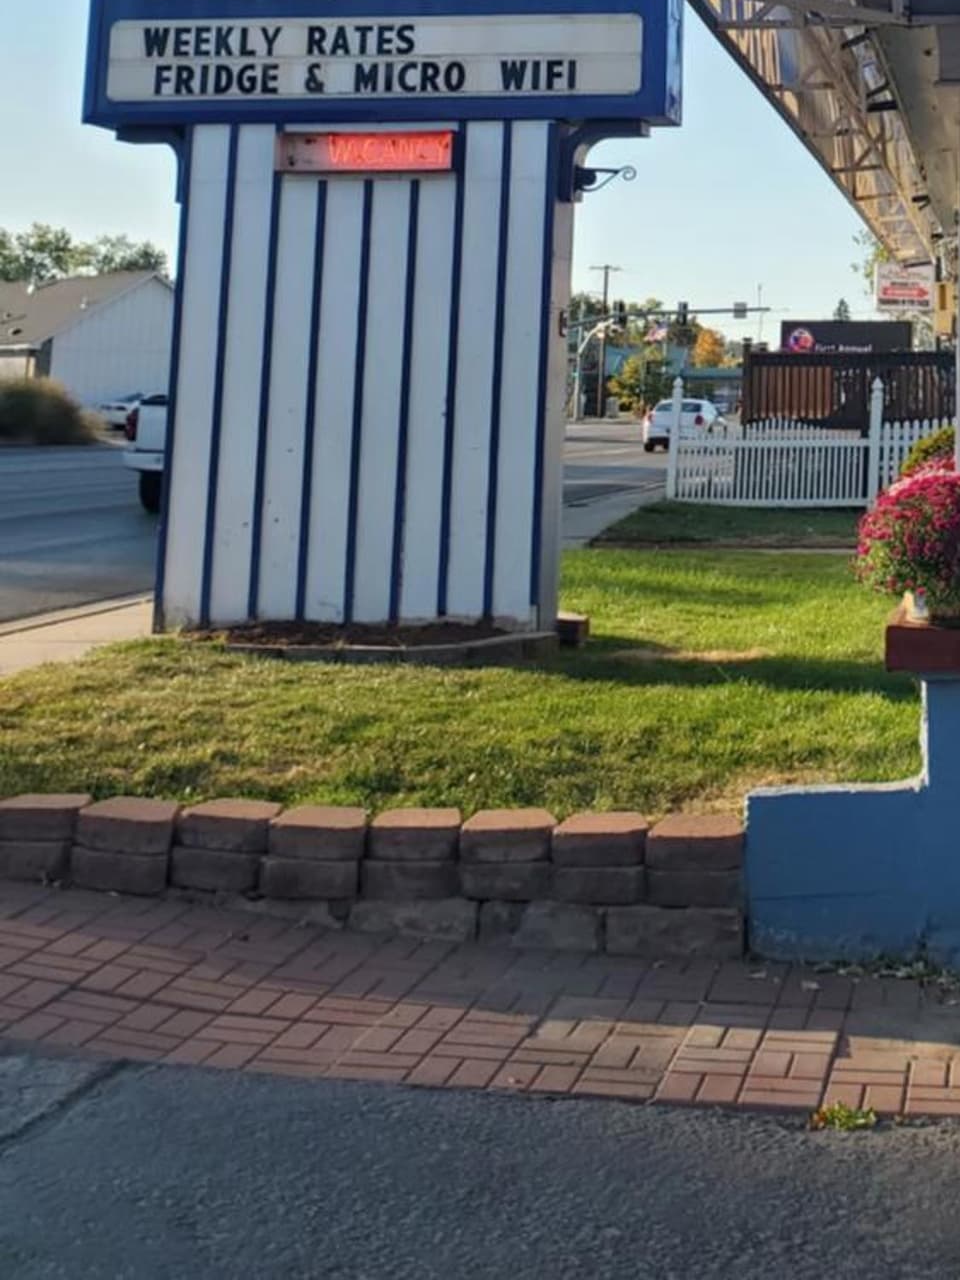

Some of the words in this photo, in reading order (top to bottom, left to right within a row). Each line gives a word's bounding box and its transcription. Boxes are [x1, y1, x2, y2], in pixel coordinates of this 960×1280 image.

[143, 26, 282, 58] WEEKLY
[306, 25, 415, 55] RATES
[153, 64, 279, 96] FRIDGE
[304, 63, 325, 94] &
[353, 61, 465, 93] MICRO
[500, 60, 577, 90] WIFI
